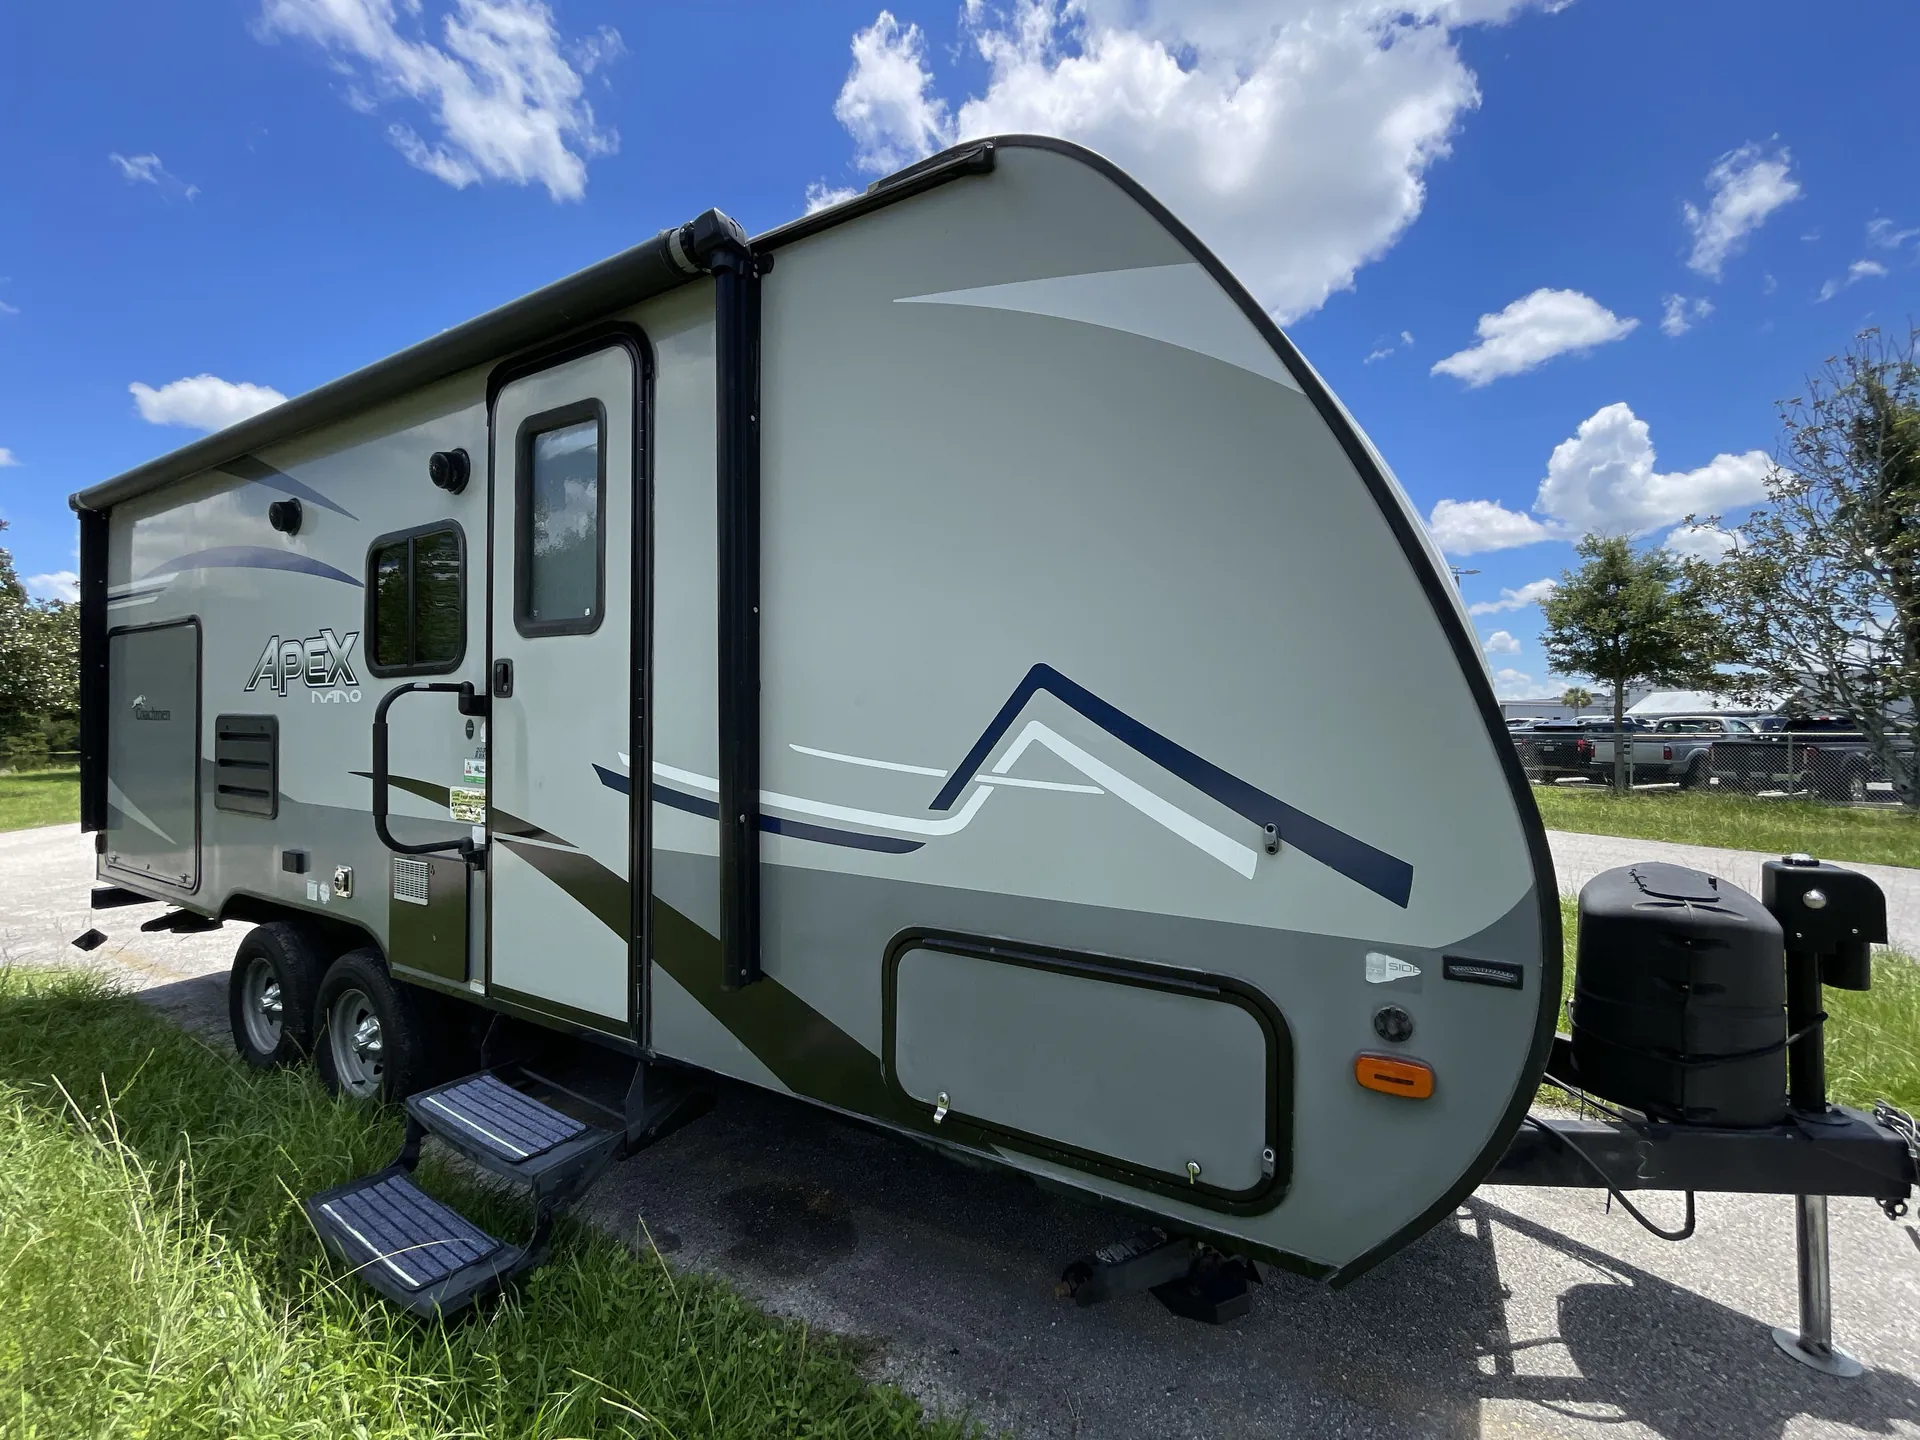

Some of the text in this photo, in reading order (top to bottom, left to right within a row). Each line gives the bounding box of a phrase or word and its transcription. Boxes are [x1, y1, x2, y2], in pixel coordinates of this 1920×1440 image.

[243, 628, 360, 697] APEX
[311, 689, 362, 704] NANO
[135, 706, 171, 721] Coachmen
